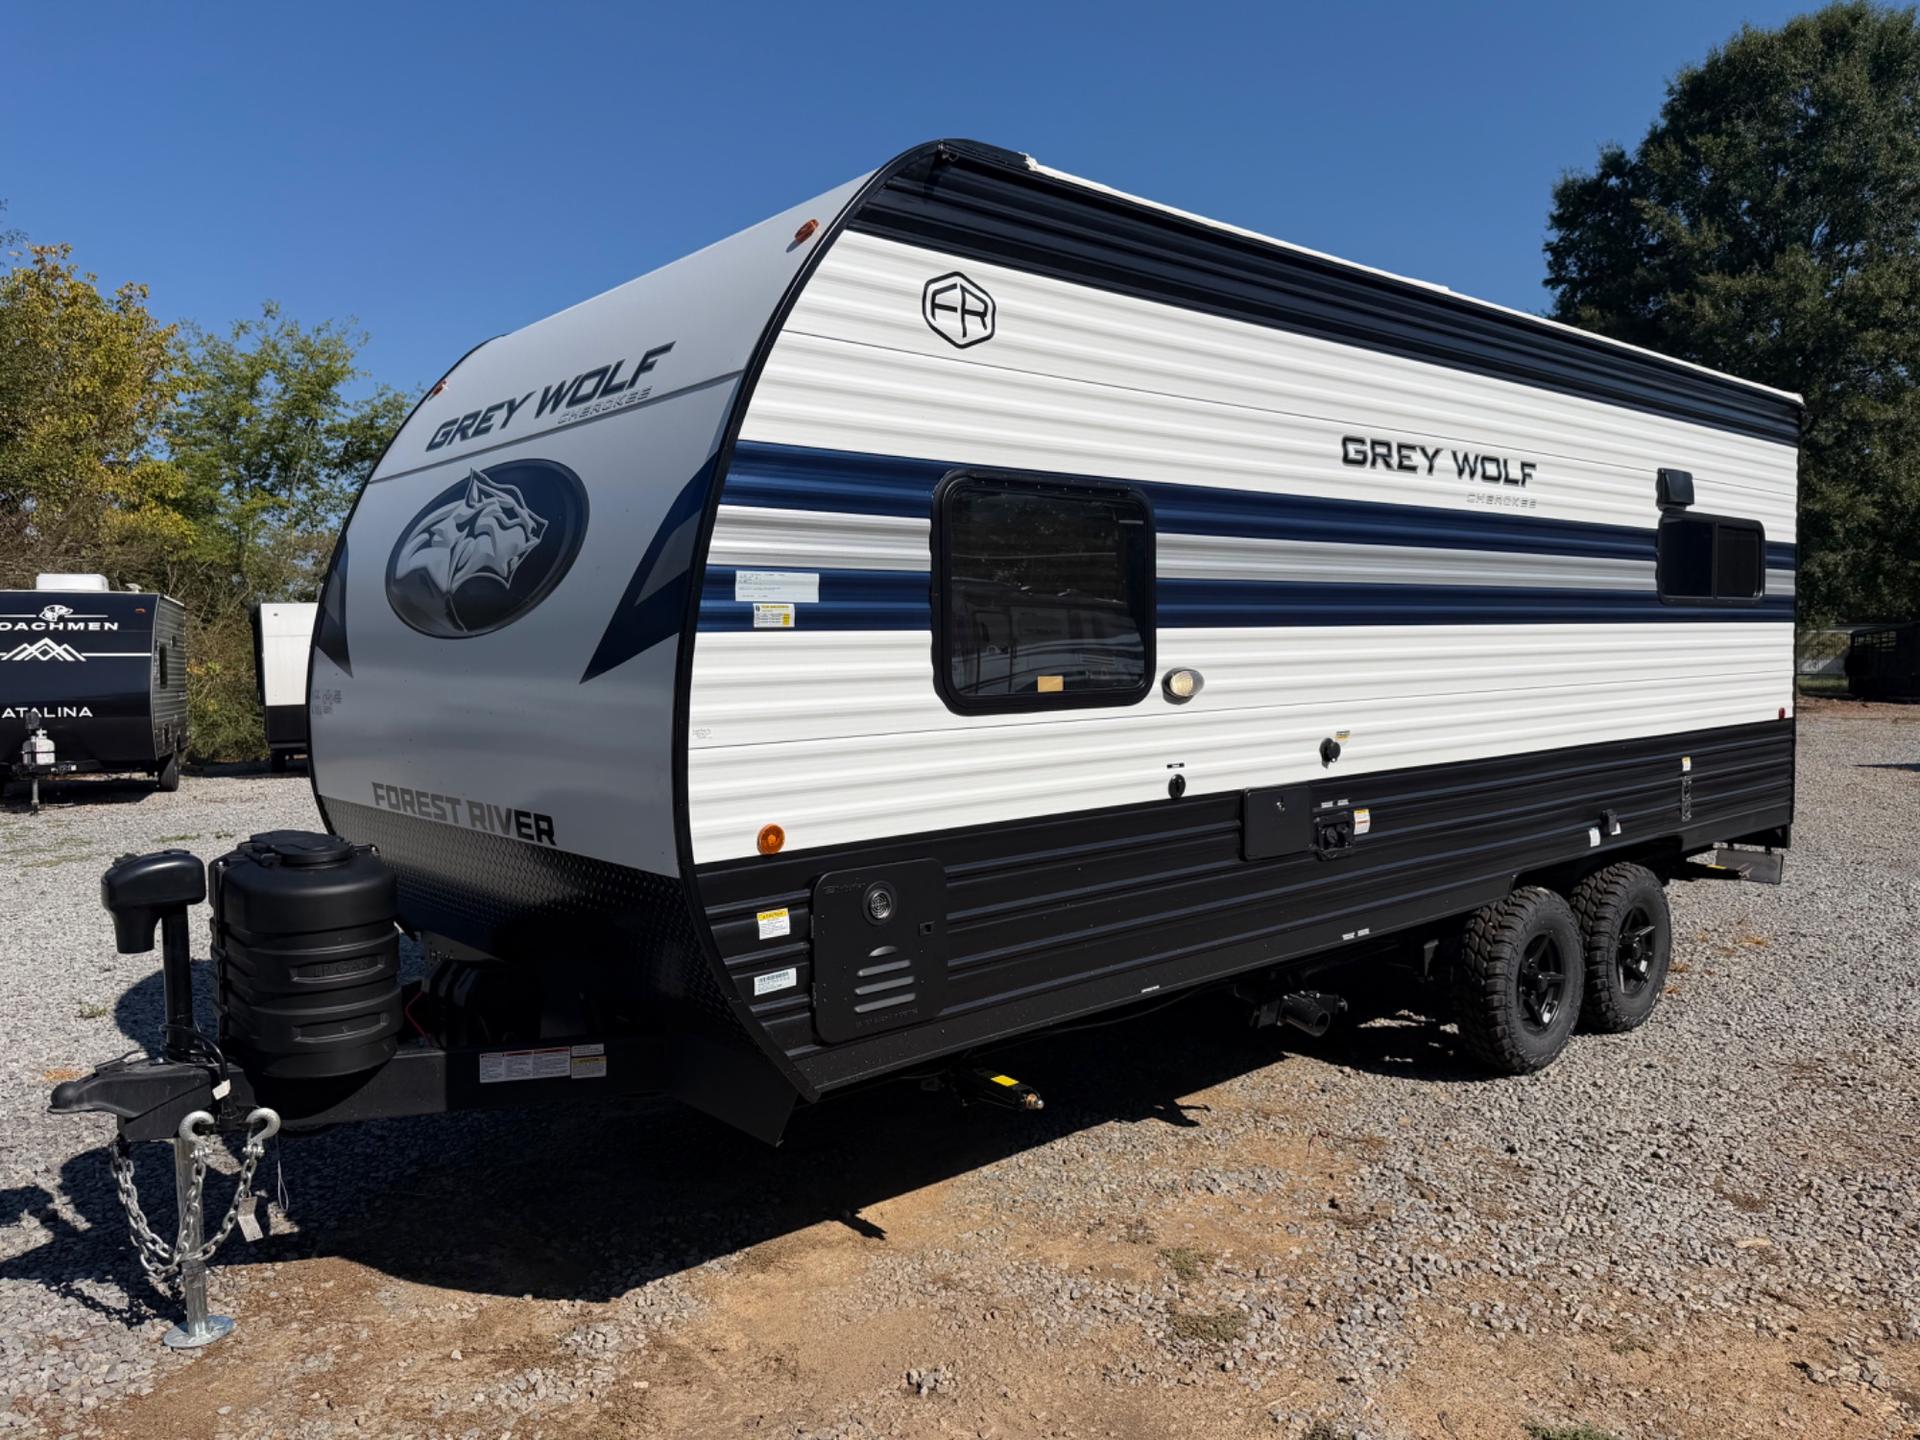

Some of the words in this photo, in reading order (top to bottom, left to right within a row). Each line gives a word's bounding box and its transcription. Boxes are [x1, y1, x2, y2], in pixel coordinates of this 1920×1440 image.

[425, 390, 537, 452] GREY
[534, 341, 676, 419] WOLF
[557, 385, 653, 424] CHEROKEE
[1342, 435, 1444, 476] GREY
[1451, 449, 1538, 488] WOLF
[1466, 492, 1538, 509] CHEROKEE
[371, 781, 462, 824] FOREST
[466, 800, 557, 846] RIVER
